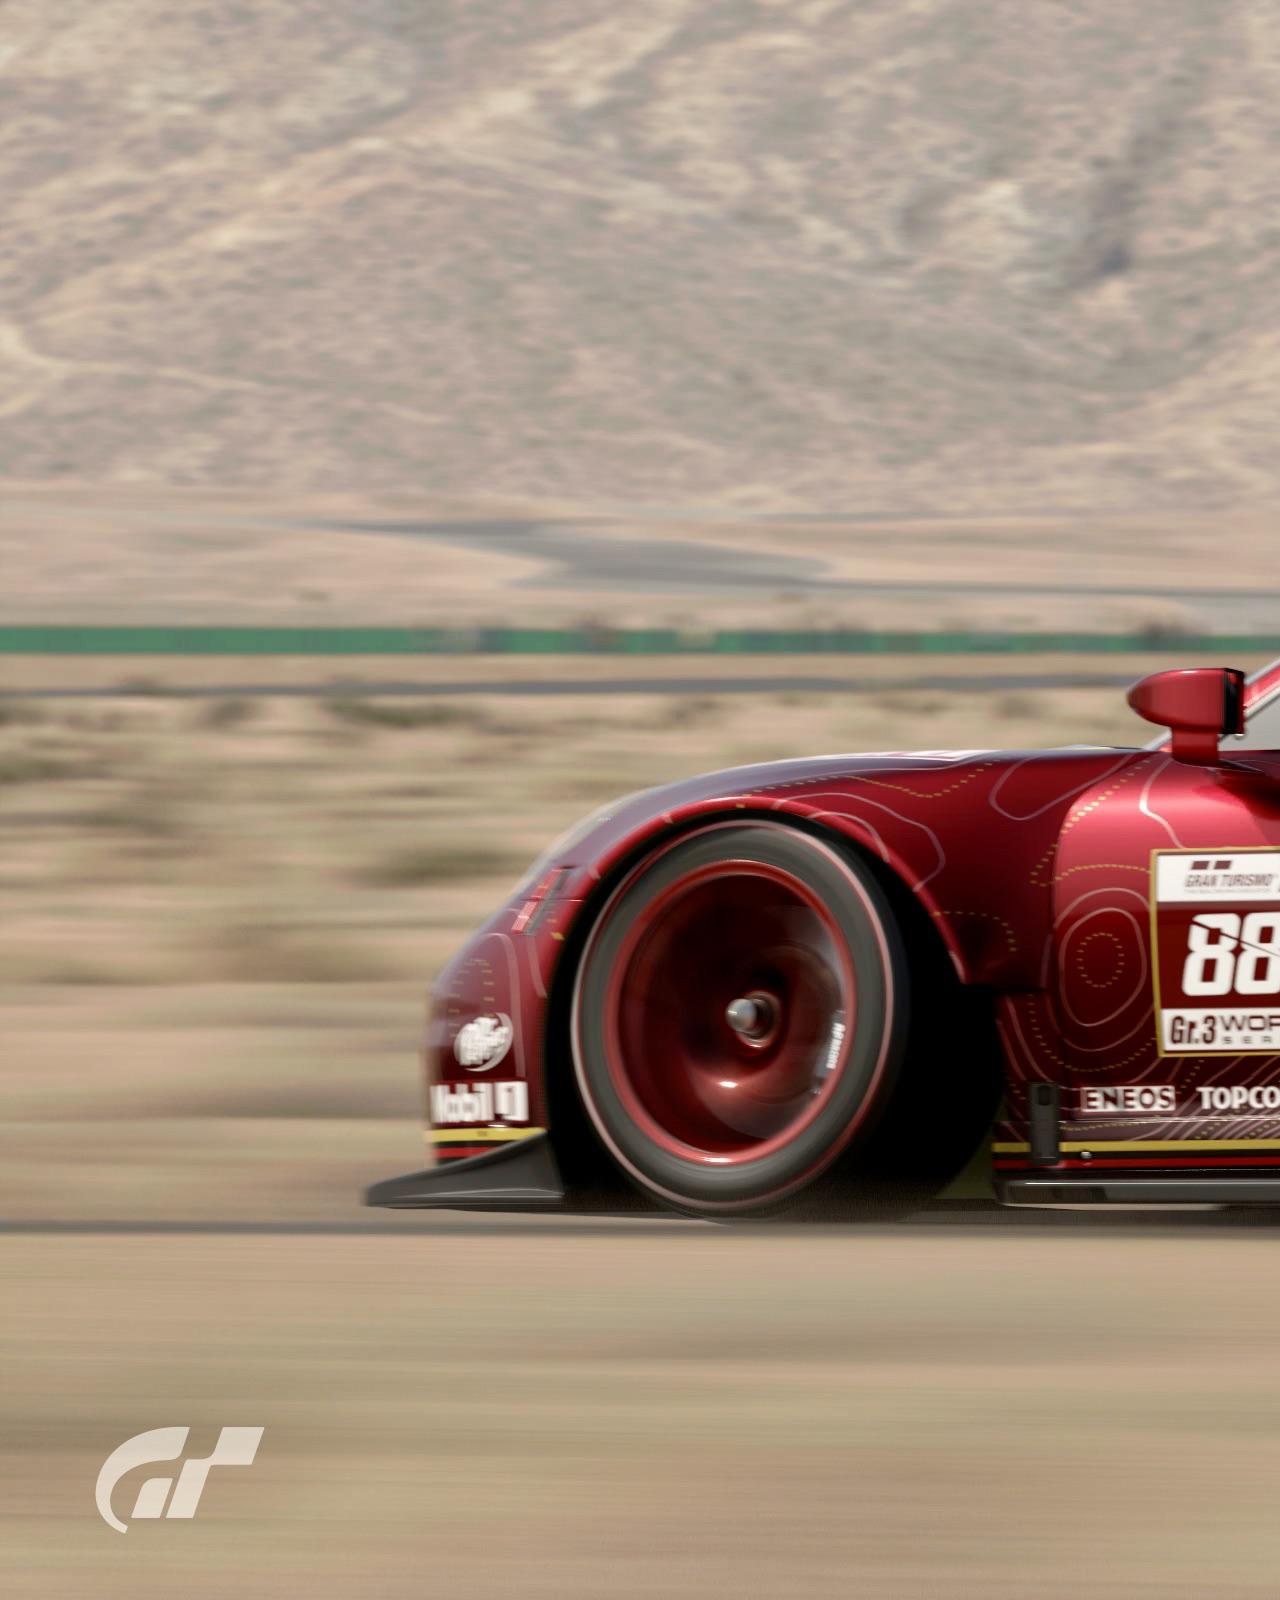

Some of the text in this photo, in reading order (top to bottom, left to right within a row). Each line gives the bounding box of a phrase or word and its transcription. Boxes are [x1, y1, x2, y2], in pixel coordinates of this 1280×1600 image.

[1184, 874, 1218, 888] GRAN
[1220, 873, 1274, 887] TURISMO
[1170, 1015, 1217, 1045] Gr.3
[1083, 1086, 1175, 1112] ENEOS
